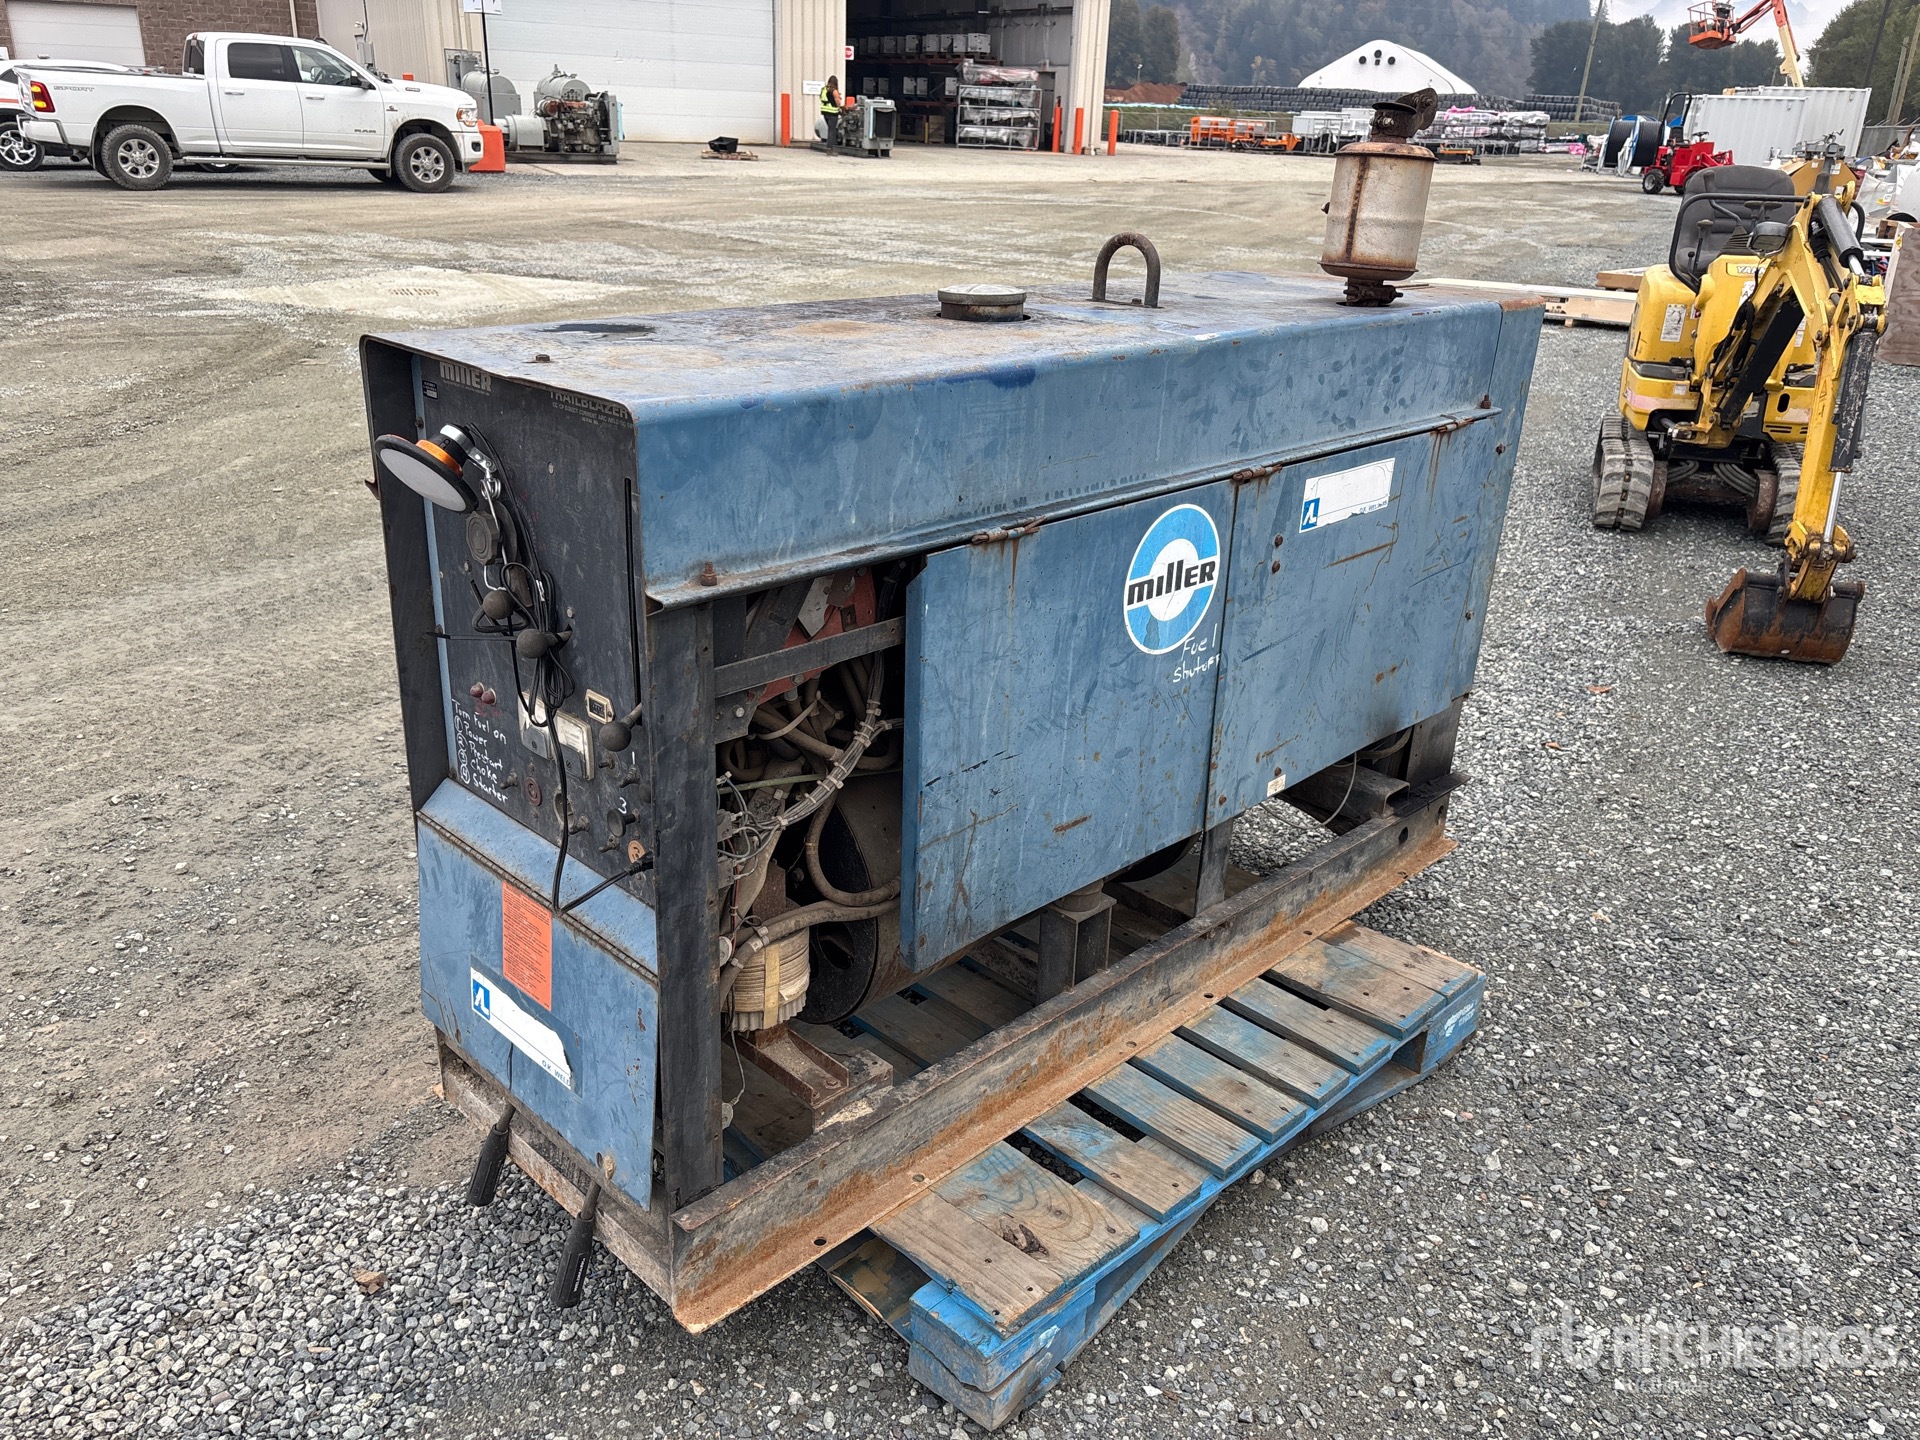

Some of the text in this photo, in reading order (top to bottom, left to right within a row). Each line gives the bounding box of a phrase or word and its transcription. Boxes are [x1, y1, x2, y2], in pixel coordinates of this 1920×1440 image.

[1180, 622, 1218, 661] Fuel
[463, 720, 488, 747] Power
[493, 729, 507, 745] on
[470, 759, 498, 784] Choke
[473, 772, 508, 804] Starter
